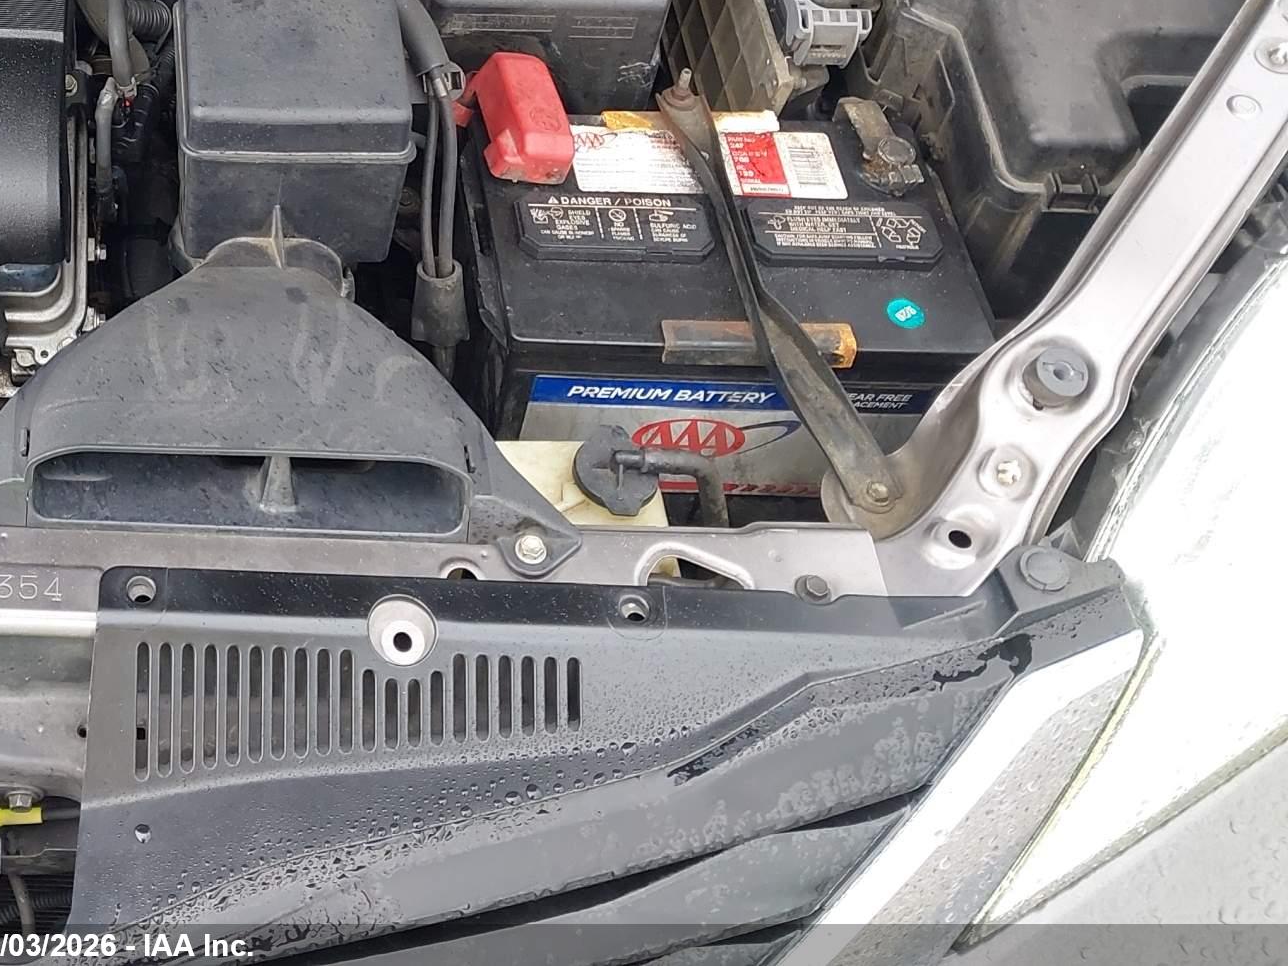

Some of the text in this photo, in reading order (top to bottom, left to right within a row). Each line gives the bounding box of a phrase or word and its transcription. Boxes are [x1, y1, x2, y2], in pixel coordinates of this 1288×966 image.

[560, 196, 612, 206] DANGER
[624, 197, 672, 207] POISON
[567, 385, 777, 404] PREMIUM BATTERY
[875, 393, 913, 402] FREE
[853, 401, 907, 409] ACEMENT
[633, 419, 745, 458] AAA
